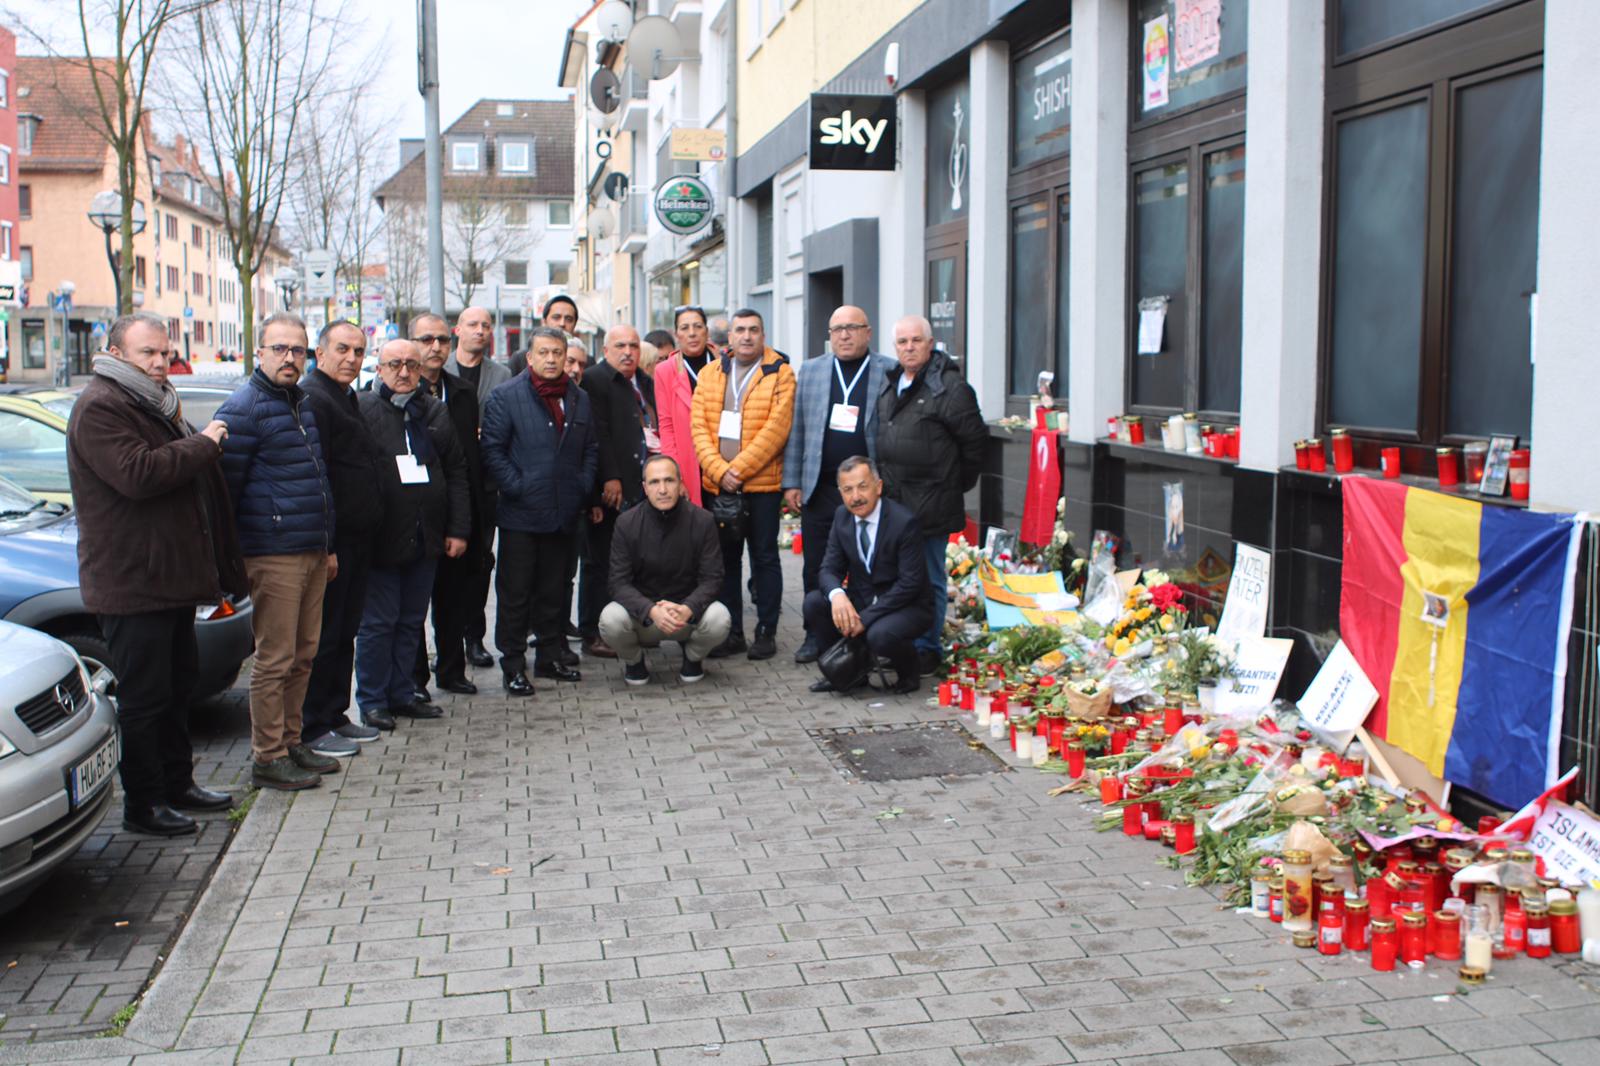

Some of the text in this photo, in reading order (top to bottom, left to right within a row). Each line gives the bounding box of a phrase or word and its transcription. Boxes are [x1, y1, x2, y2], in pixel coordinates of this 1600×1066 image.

[1034, 73, 1072, 120] SHISH
[819, 109, 888, 153] sky
[659, 200, 708, 210] Heineken
[80, 759, 93, 795] HU
[1530, 830, 1556, 854] IST
